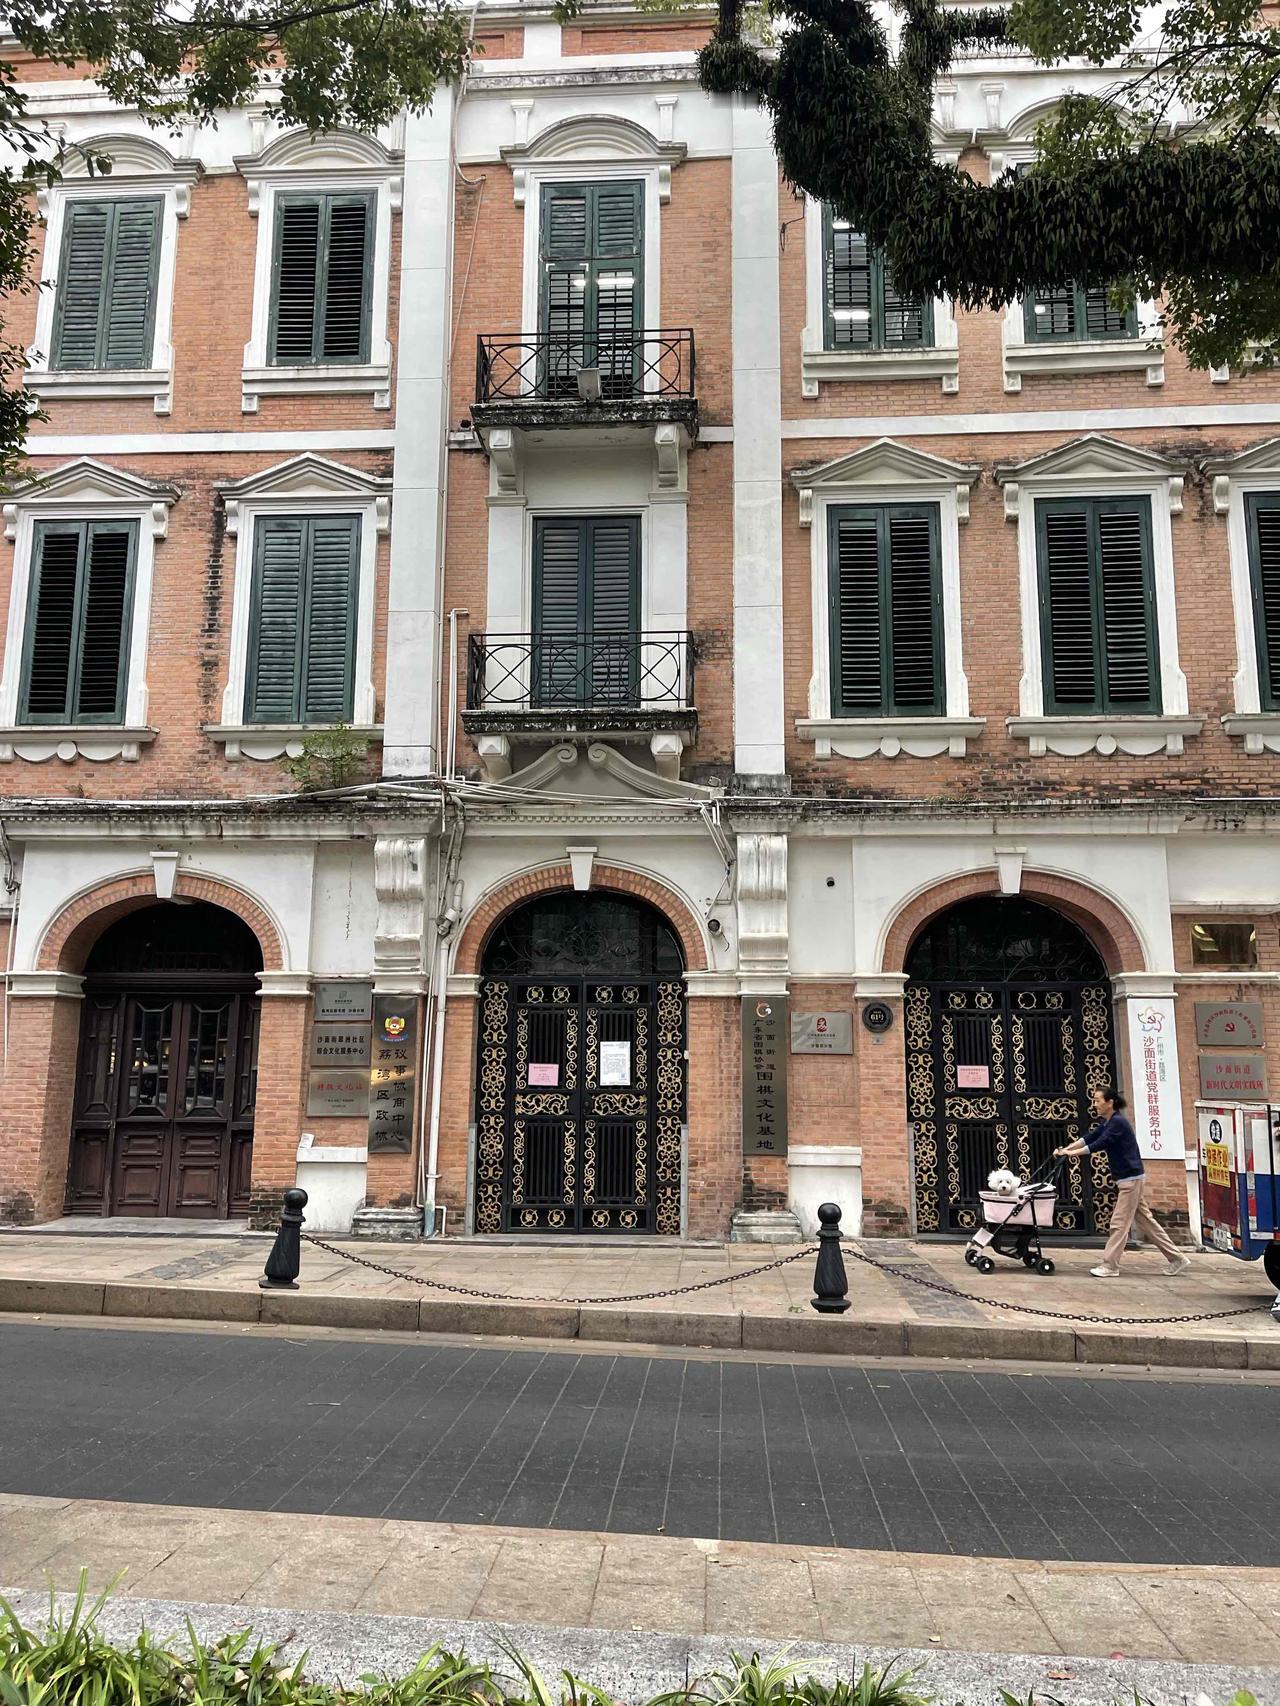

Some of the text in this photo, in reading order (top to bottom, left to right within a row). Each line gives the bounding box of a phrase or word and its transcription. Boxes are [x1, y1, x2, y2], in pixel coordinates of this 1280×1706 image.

[316, 1047, 365, 1055] 综合文化服务中心
[765, 1019, 776, 1070] 沙面街道
[1215, 1064, 1250, 1074] 沙面街道
[375, 1048, 392, 1142] 荔湾区政协
[390, 1048, 408, 1142] 议事协商中心
[755, 1071, 775, 1150] 围棋文化基地
[1143, 1036, 1163, 1152] 沙面街道党群服务中心
[1206, 1079, 1264, 1090] 新时代文明实践所
